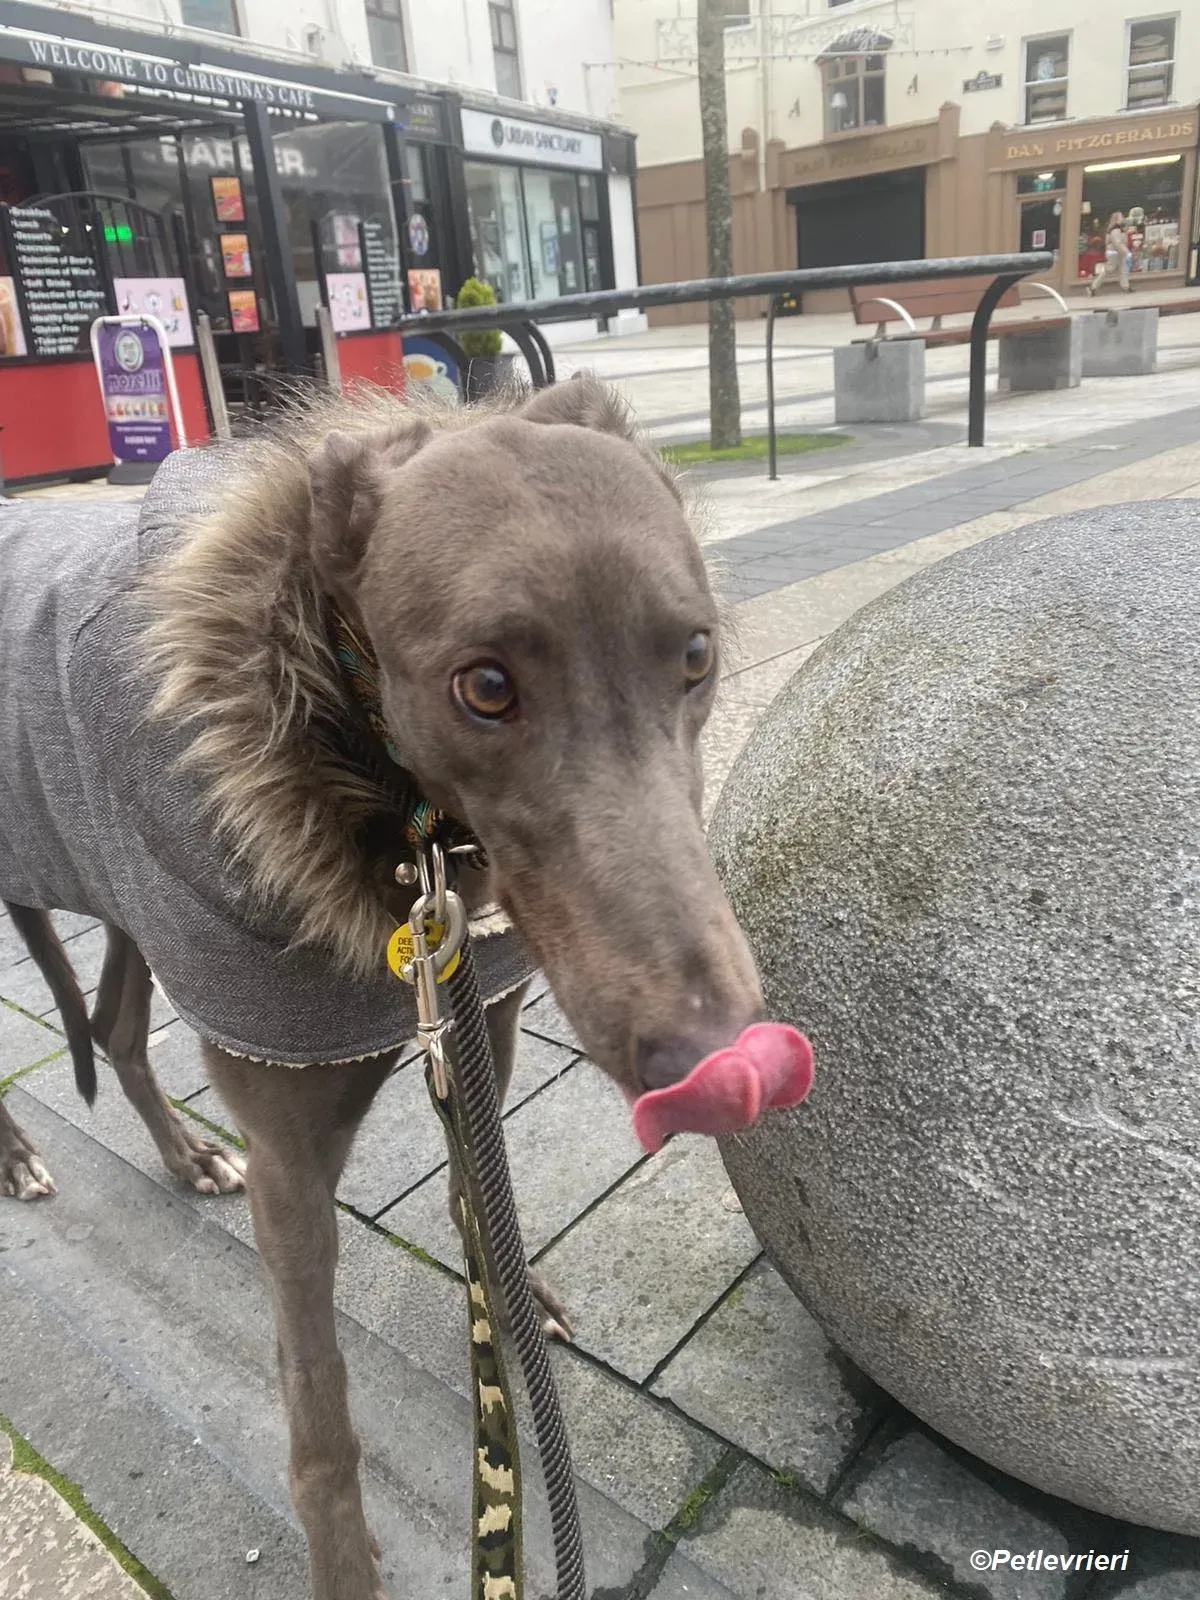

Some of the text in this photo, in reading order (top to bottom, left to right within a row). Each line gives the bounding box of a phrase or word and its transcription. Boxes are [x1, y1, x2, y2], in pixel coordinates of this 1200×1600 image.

[29, 40, 137, 78] WELCOME
[141, 62, 167, 83] TO
[174, 68, 275, 100] CHRISTINA'S
[279, 88, 315, 108] CAFE
[1007, 122, 1193, 159] DAN FITZGERALDS
[398, 937, 413, 946] DEE
